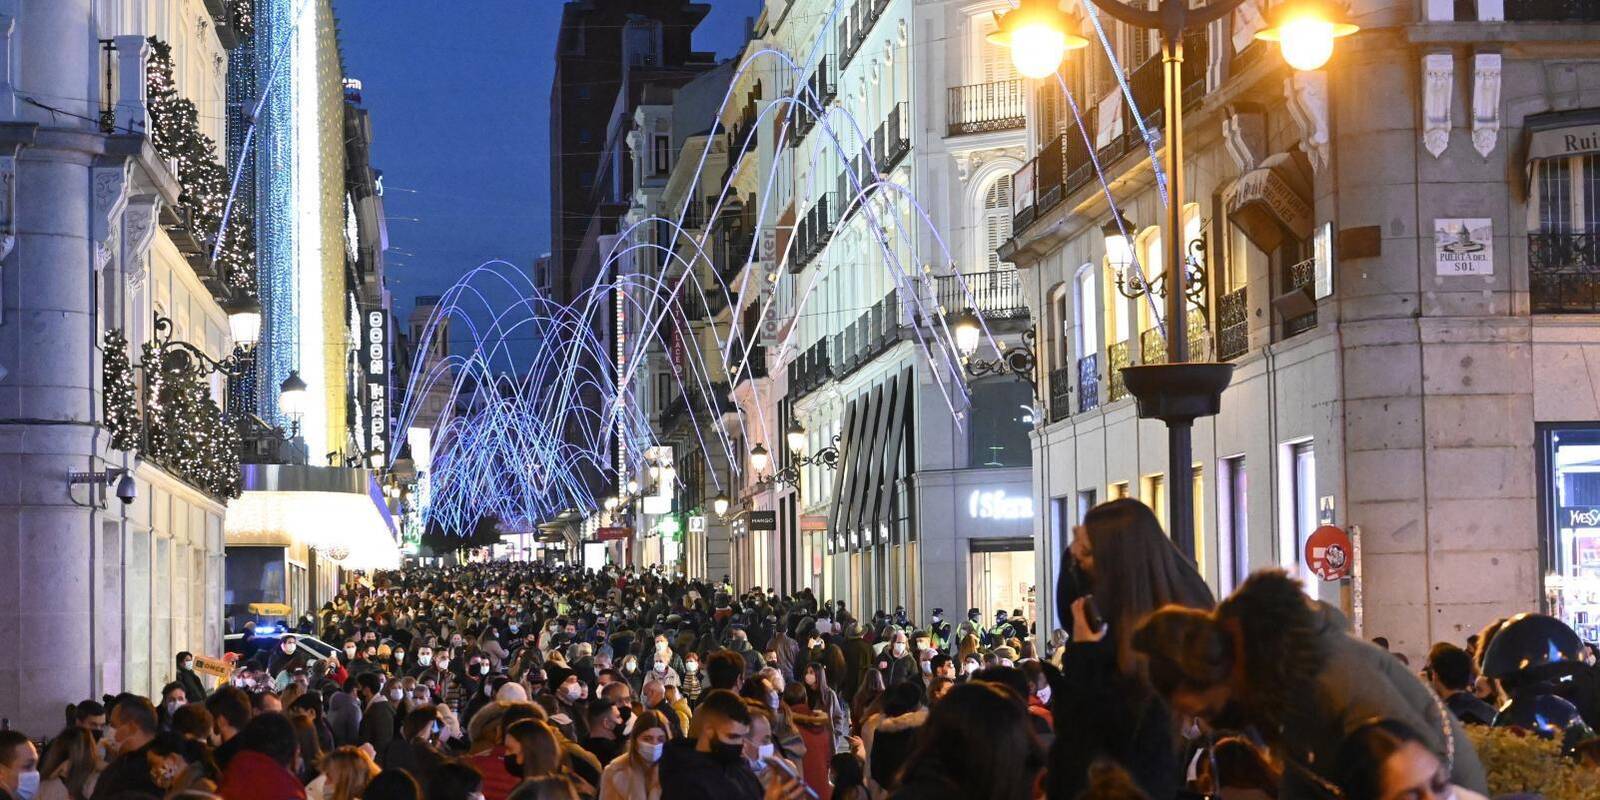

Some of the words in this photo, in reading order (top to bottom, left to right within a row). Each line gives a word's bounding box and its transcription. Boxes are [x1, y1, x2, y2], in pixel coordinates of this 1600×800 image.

[1564, 132, 1600, 151] Rui
[1440, 253, 1472, 262] PUERTA
[1454, 261, 1475, 272] SOL
[370, 383, 385, 467] PORT
